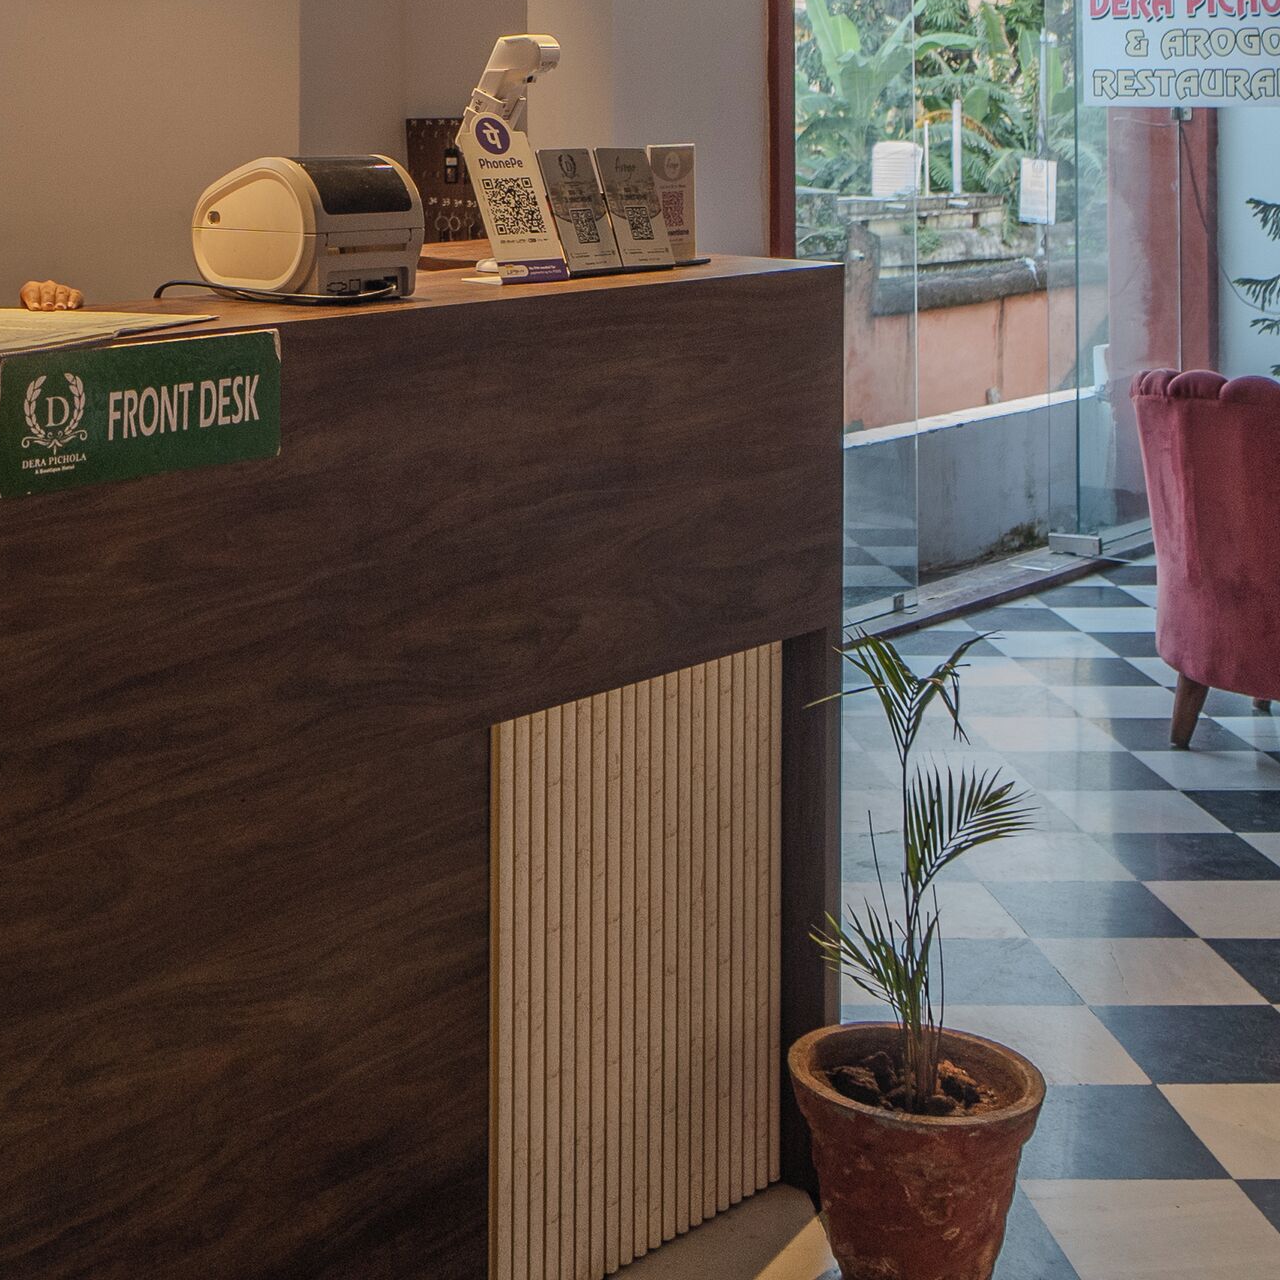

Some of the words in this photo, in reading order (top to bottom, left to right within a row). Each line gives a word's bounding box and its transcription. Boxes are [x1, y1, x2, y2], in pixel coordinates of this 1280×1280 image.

[1125, 29, 1149, 57] &
[478, 157, 524, 170] PhonePe
[45, 395, 70, 427] D
[108, 382, 194, 440] FRONT
[199, 374, 260, 428] DESK
[22, 458, 47, 470] DERA
[48, 452, 87, 466] PICHOLA
